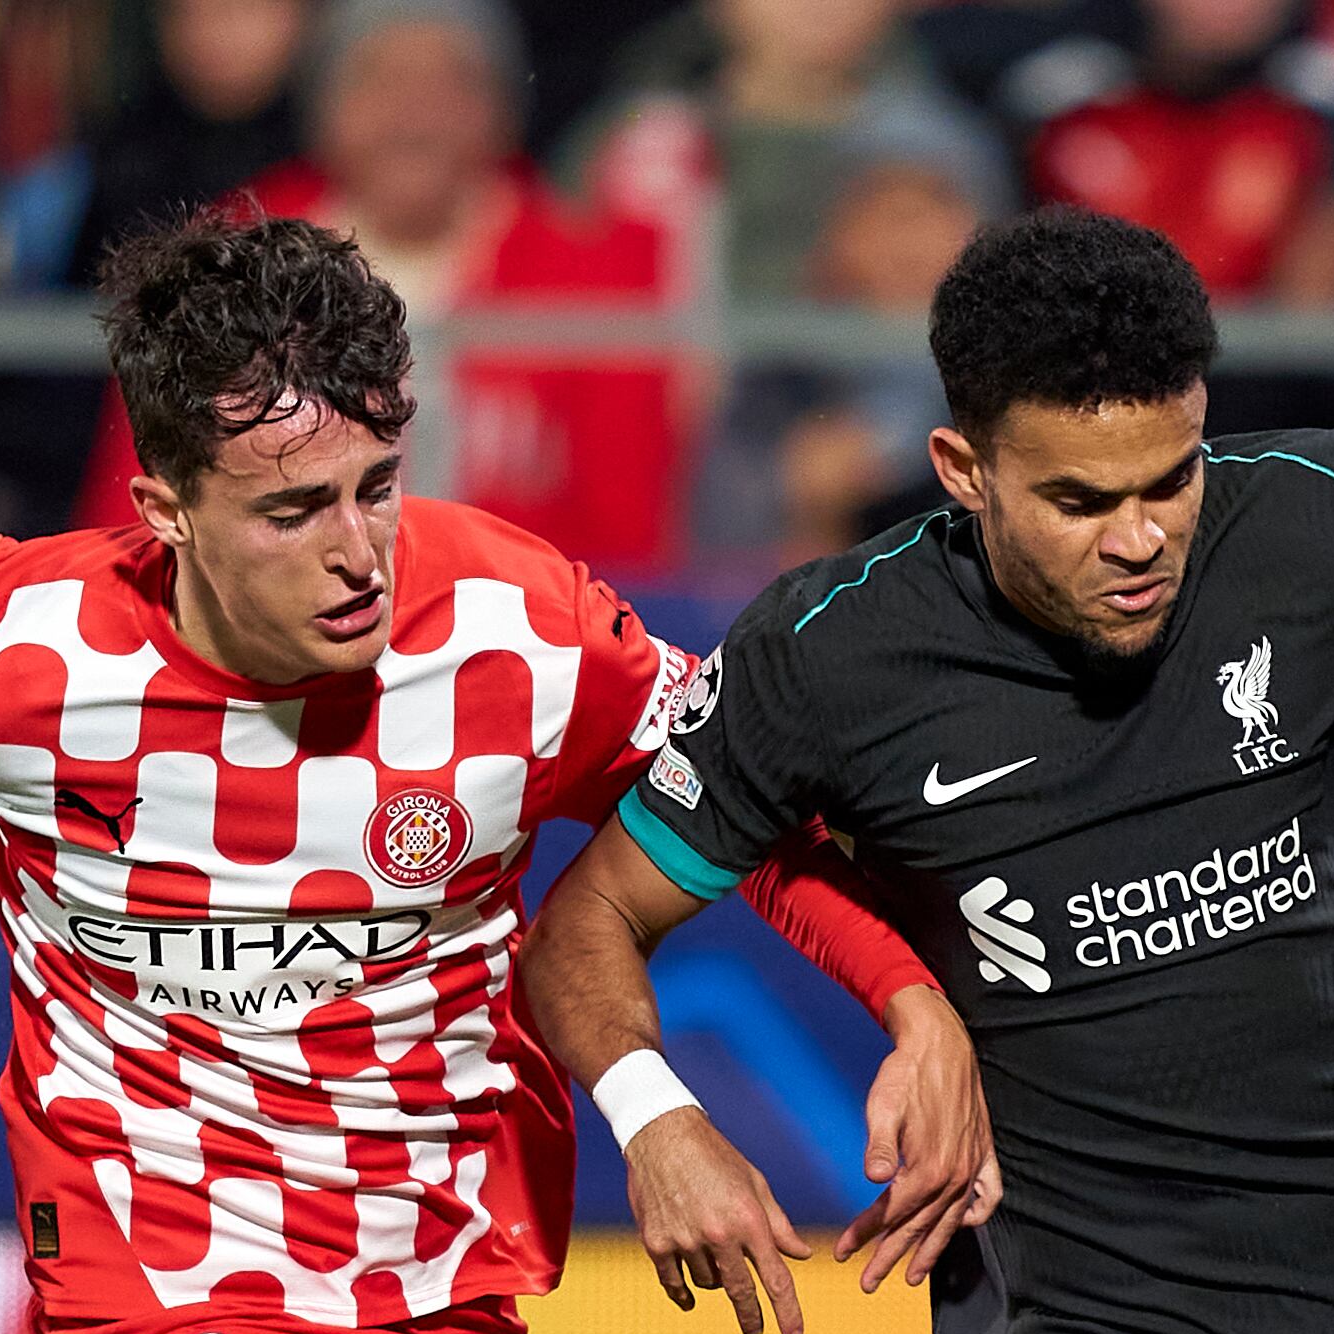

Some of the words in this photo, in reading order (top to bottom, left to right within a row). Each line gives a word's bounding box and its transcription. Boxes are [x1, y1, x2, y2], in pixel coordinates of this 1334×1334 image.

[1232, 738, 1299, 775] L.F.C.
[386, 795, 451, 818] GIRONA
[386, 863, 421, 879] FUTBOL
[424, 859, 448, 876] CLUB
[1067, 816, 1300, 929] standard
[1075, 853, 1316, 967] chartered
[68, 909, 431, 970] ETIHAD
[149, 977, 353, 1016] AIRWAYS
